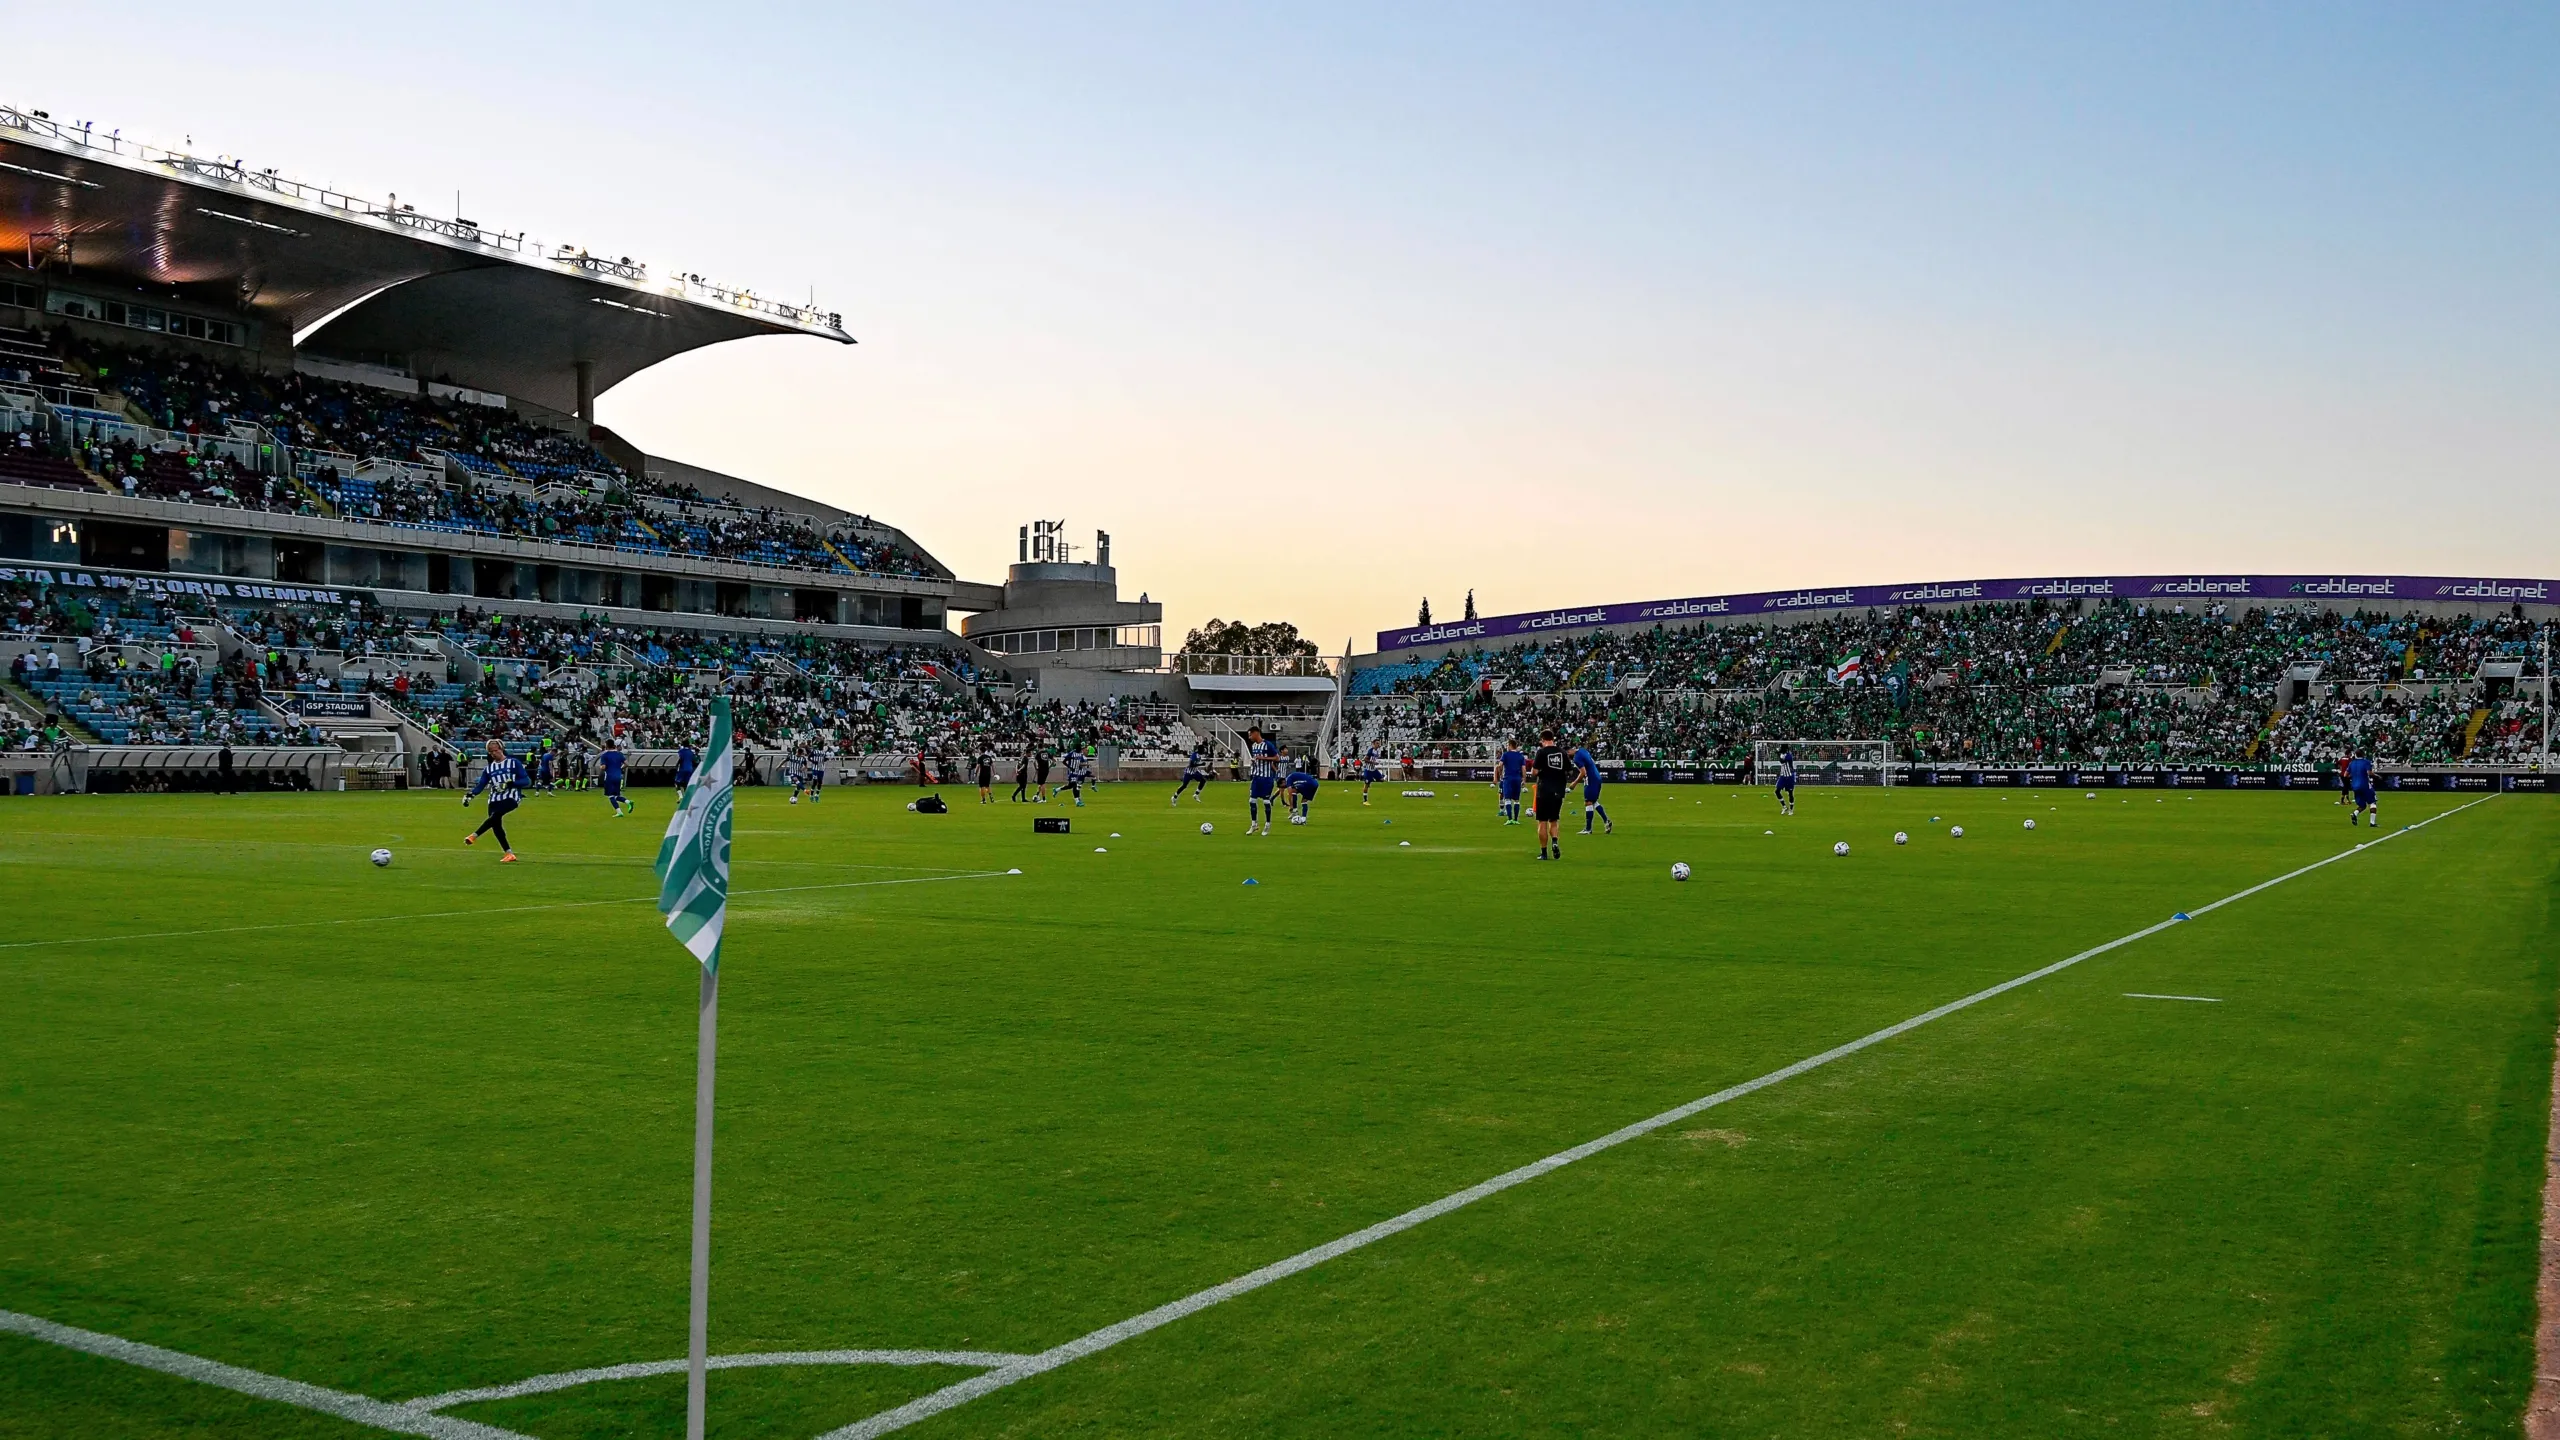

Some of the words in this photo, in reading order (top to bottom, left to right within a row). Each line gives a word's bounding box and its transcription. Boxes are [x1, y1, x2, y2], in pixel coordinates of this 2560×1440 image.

[61, 572, 96, 587] LA
[234, 584, 343, 604] SIEMPRE
[1902, 582, 1982, 600] cablenet
[2031, 579, 2113, 595] cablenet
[2165, 578, 2250, 593] cablenet
[2304, 578, 2395, 594] cablenet
[2452, 580, 2548, 599] cablenet
[1653, 598, 1729, 616] cablenet
[1776, 590, 1854, 607] cablenet
[1531, 608, 1607, 628] cablenet
[1410, 621, 1485, 643] cablenet
[306, 702, 324, 710] GSP
